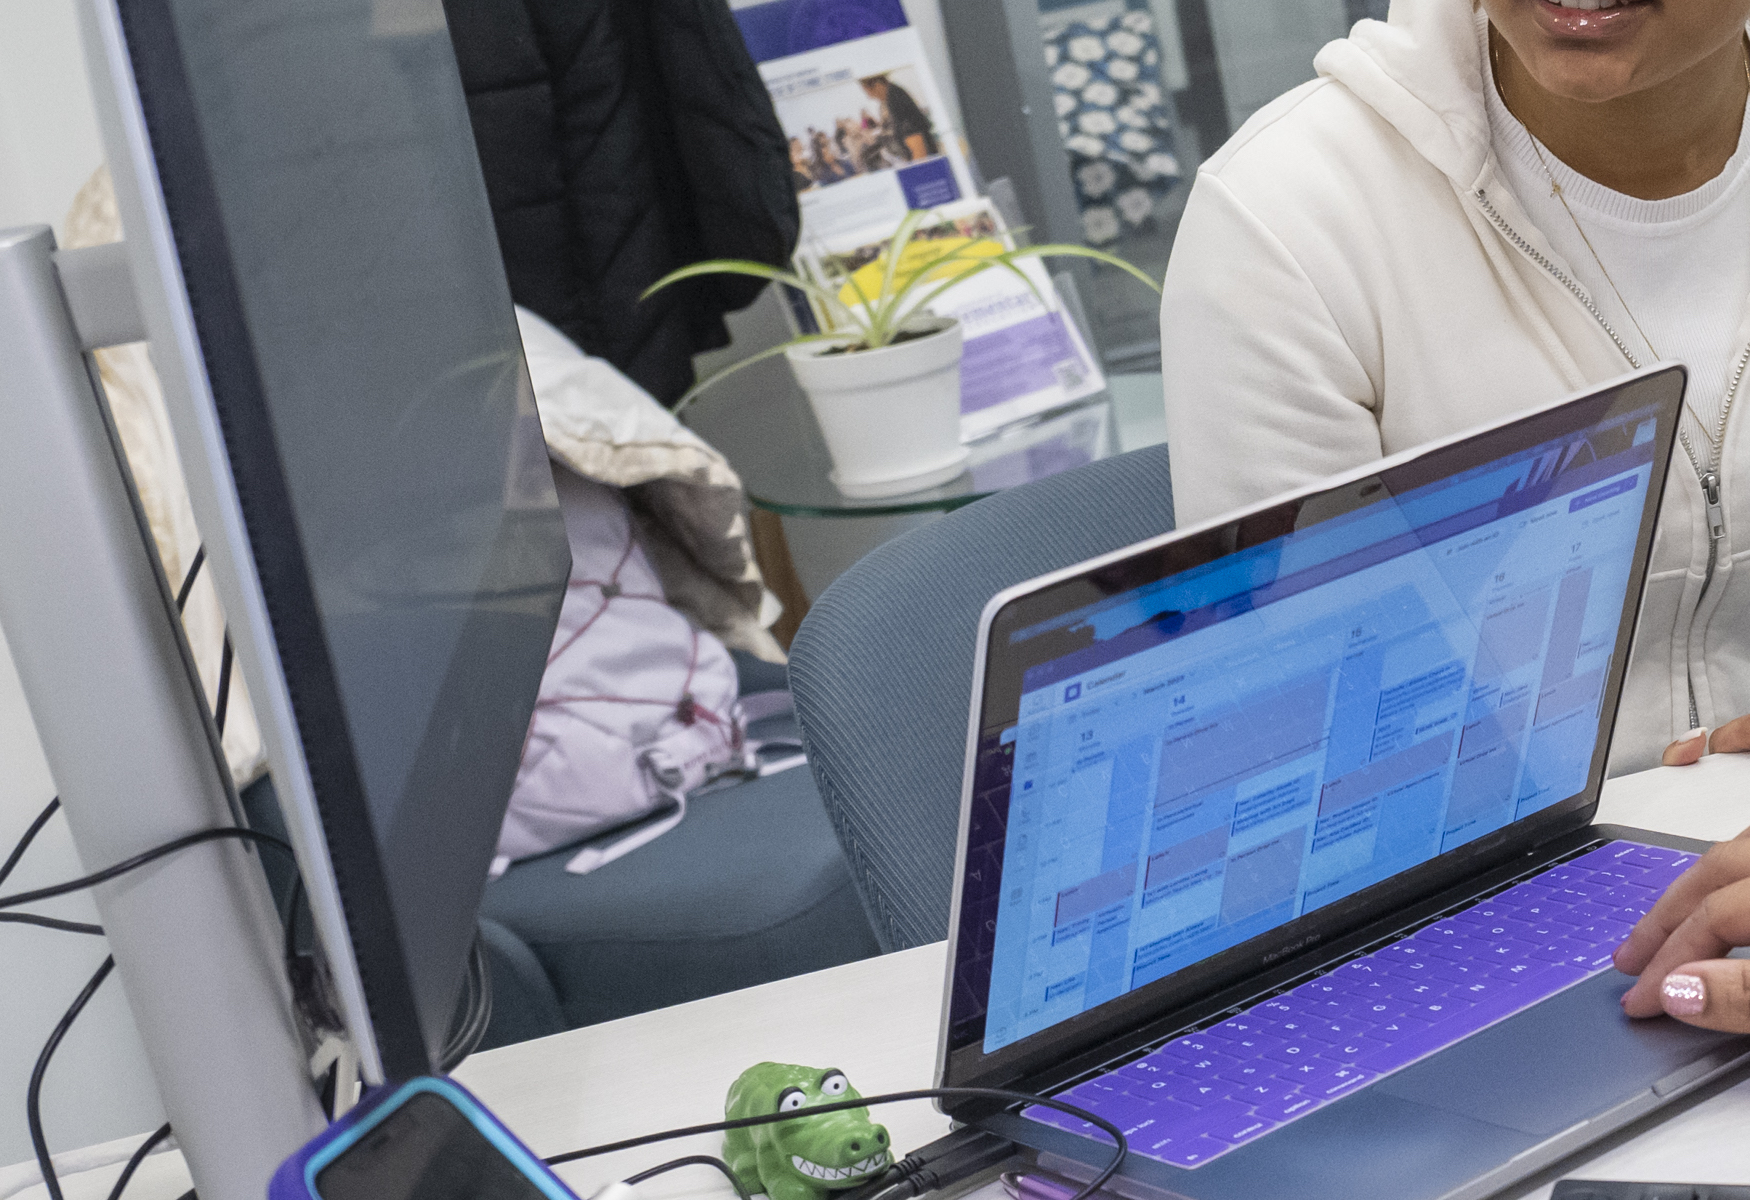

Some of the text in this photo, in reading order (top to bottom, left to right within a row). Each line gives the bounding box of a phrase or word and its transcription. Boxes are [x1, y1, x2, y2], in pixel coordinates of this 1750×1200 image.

[1570, 542, 1581, 552] 17
[1494, 572, 1505, 583] 16
[1086, 670, 1125, 690] Calendar
[1173, 694, 1186, 706] 14
[1080, 729, 1093, 742] 13
[1671, 857, 1689, 867] enter
[1263, 934, 1321, 964] MacBook Pro
[1510, 964, 1528, 974] M
[1414, 985, 1429, 993] H
[1469, 984, 1485, 992] N
[1372, 1004, 1387, 1012] G
[1344, 1046, 1359, 1054] C
[1195, 1059, 1212, 1069] W
[1299, 1065, 1315, 1073] X
[1152, 1081, 1167, 1089] Q
[1199, 1086, 1212, 1094] A
[1254, 1085, 1269, 1094] Z
[1284, 1099, 1311, 1114] option
[1233, 1122, 1263, 1139] control
